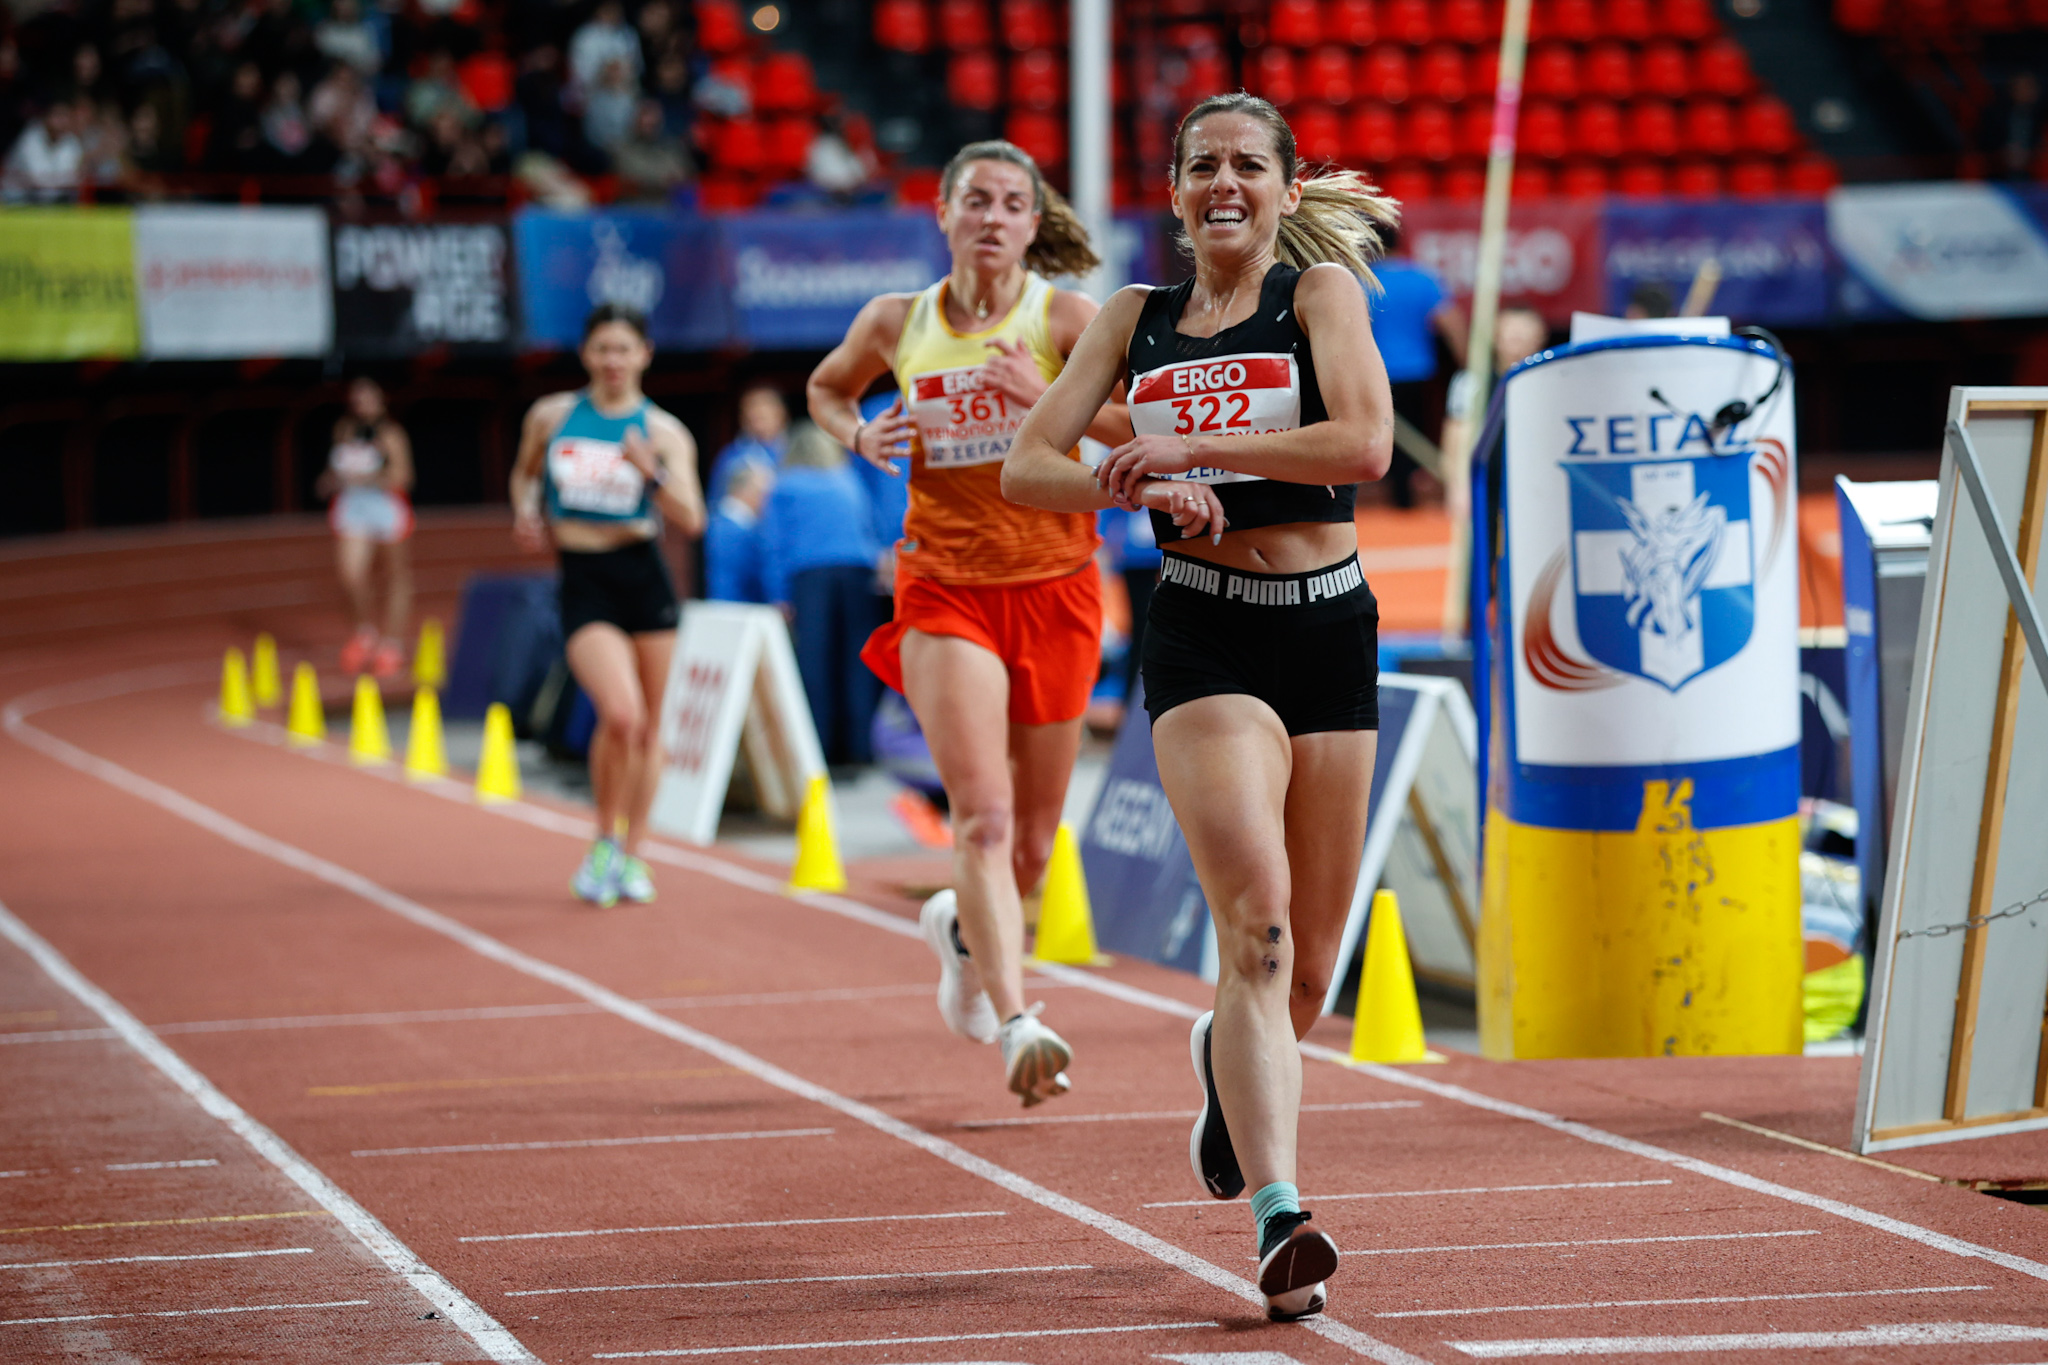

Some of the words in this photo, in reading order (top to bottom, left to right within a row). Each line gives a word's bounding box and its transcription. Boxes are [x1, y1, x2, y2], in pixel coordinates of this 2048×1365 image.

[337, 224, 504, 289] POWER
[1172, 362, 1247, 394] ERGO
[947, 393, 1006, 425] 361
[1171, 393, 1252, 436] 322
[1162, 556, 1221, 596] PUMA
[1226, 574, 1301, 606] PUMA
[1307, 560, 1363, 603] PUMA
